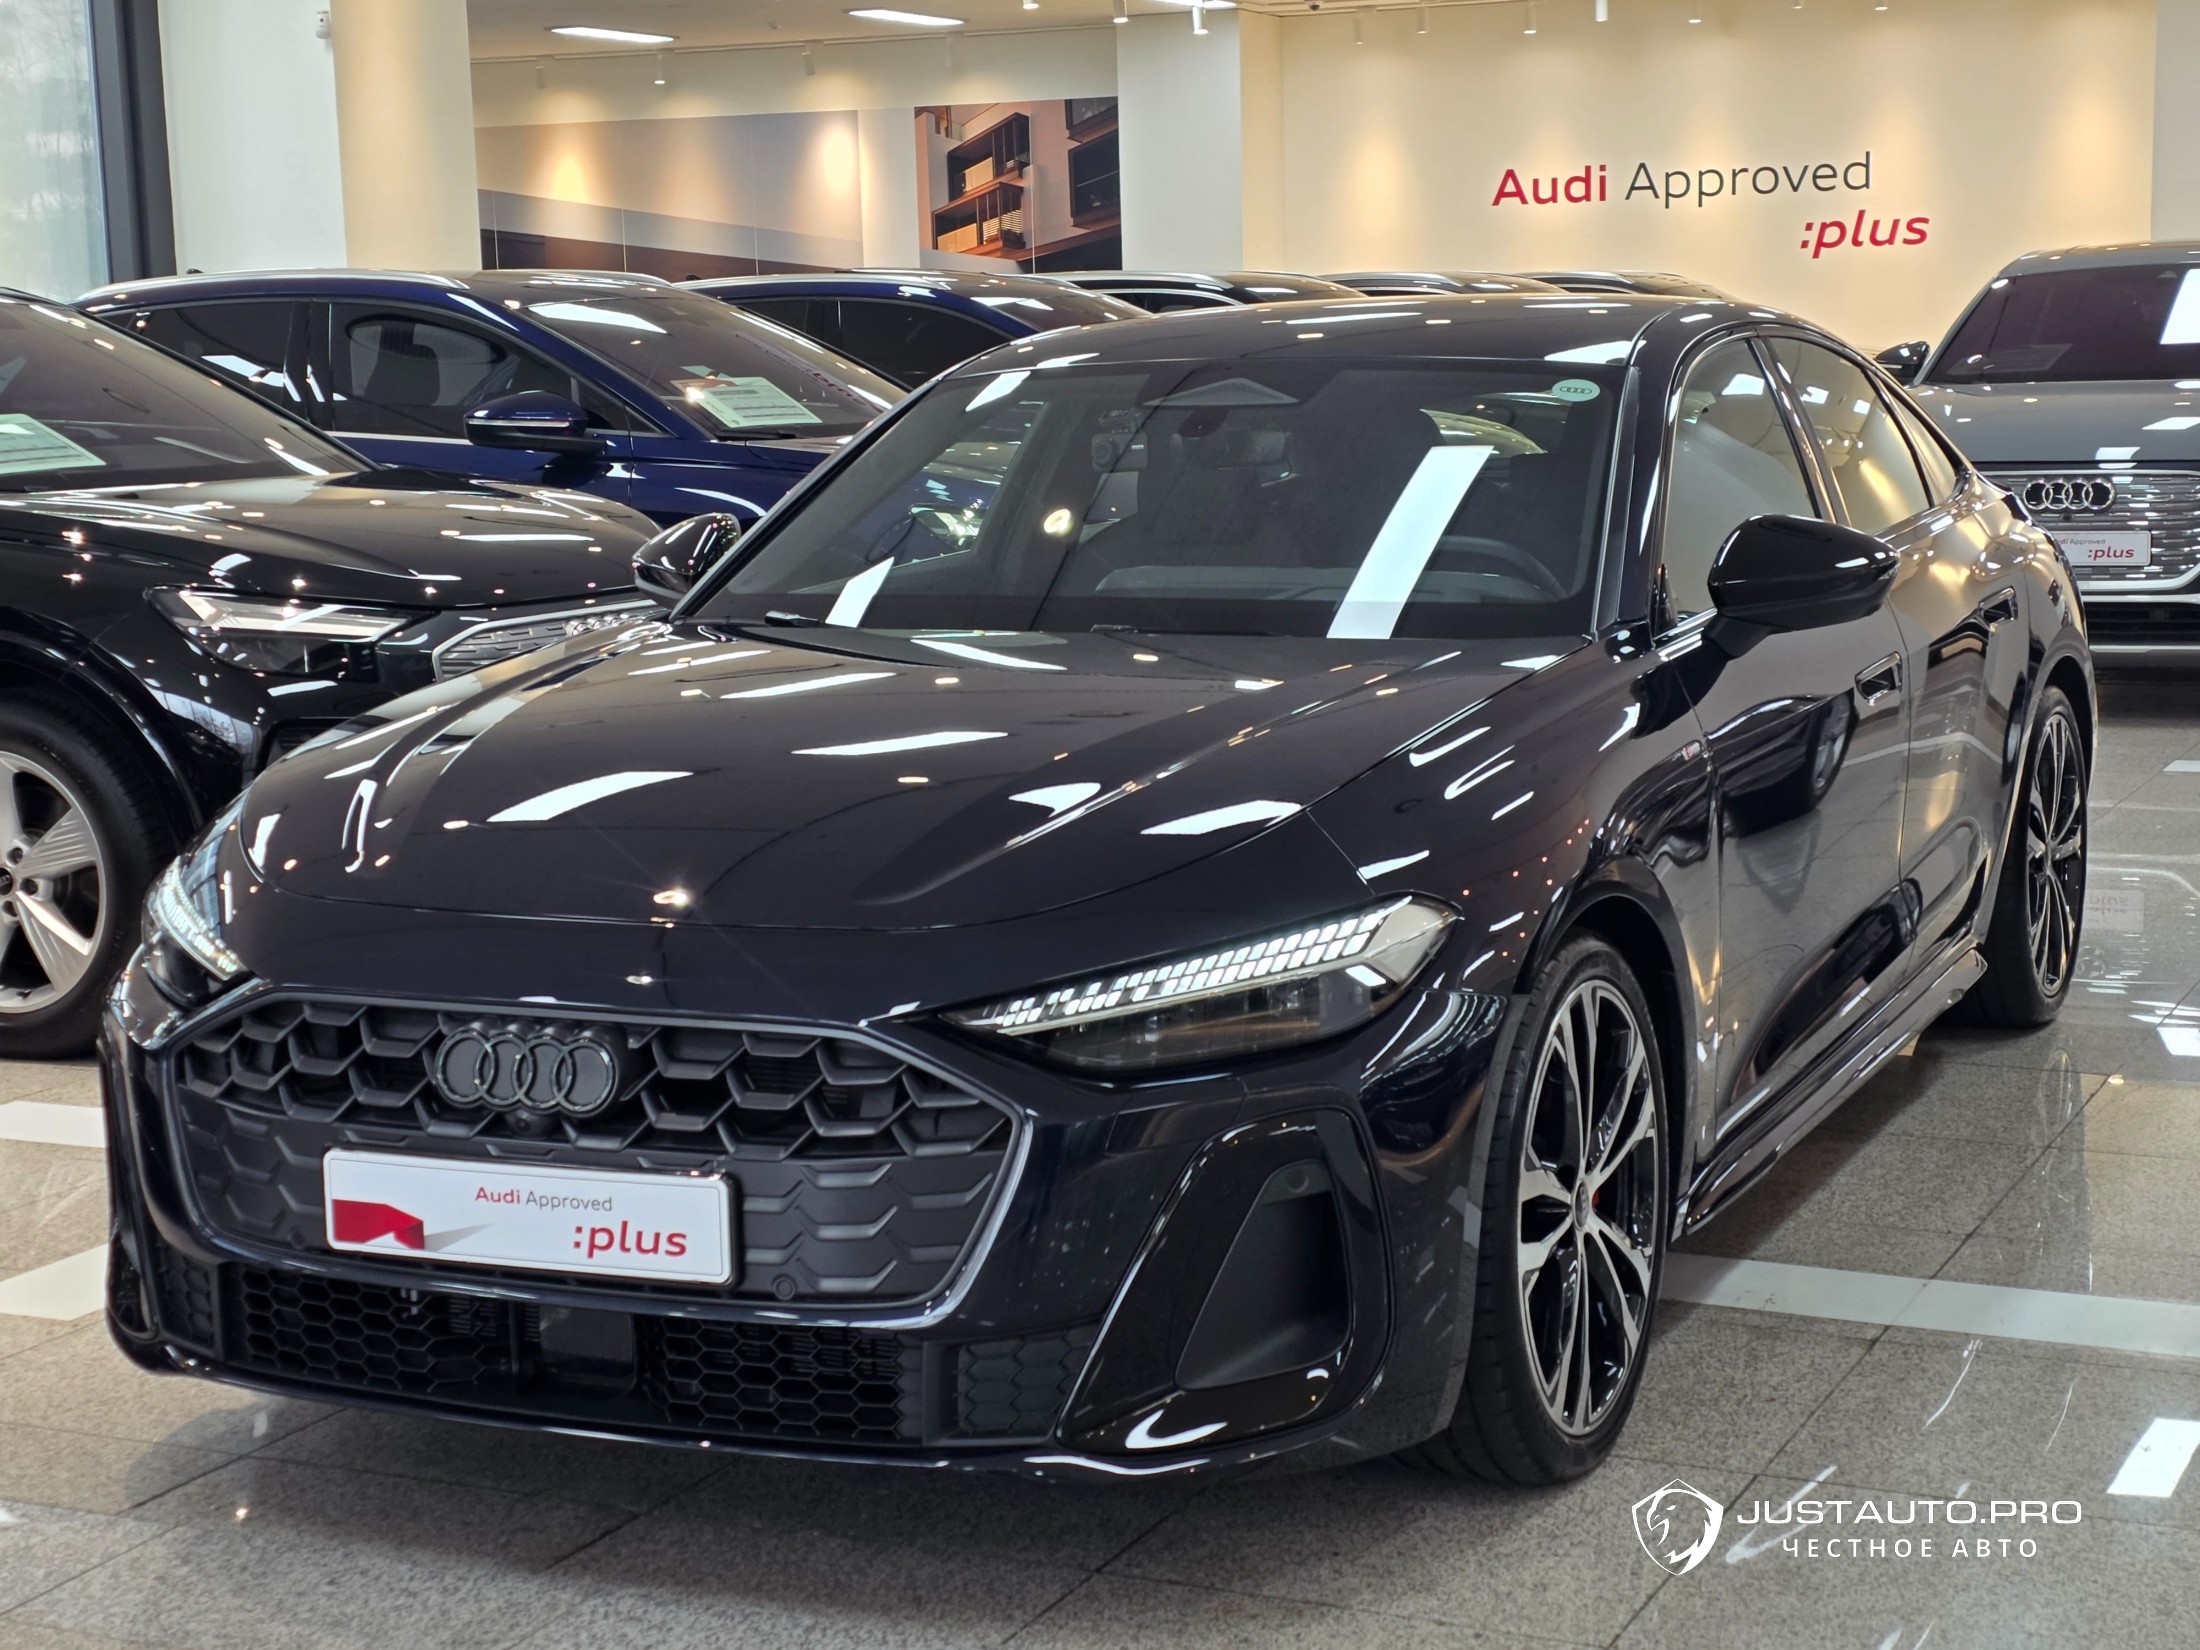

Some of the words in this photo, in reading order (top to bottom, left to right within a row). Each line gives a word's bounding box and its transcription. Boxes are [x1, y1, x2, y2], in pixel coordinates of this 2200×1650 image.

[1492, 165, 1607, 206] Audi
[1625, 151, 1871, 209] Approved
[1800, 210, 1930, 258] :plus
[2070, 538, 2106, 546] Approved
[2088, 546, 2135, 561] :plus
[475, 1187, 521, 1205] Audi
[525, 1191, 613, 1211] Approved
[573, 1220, 687, 1259] :plus
